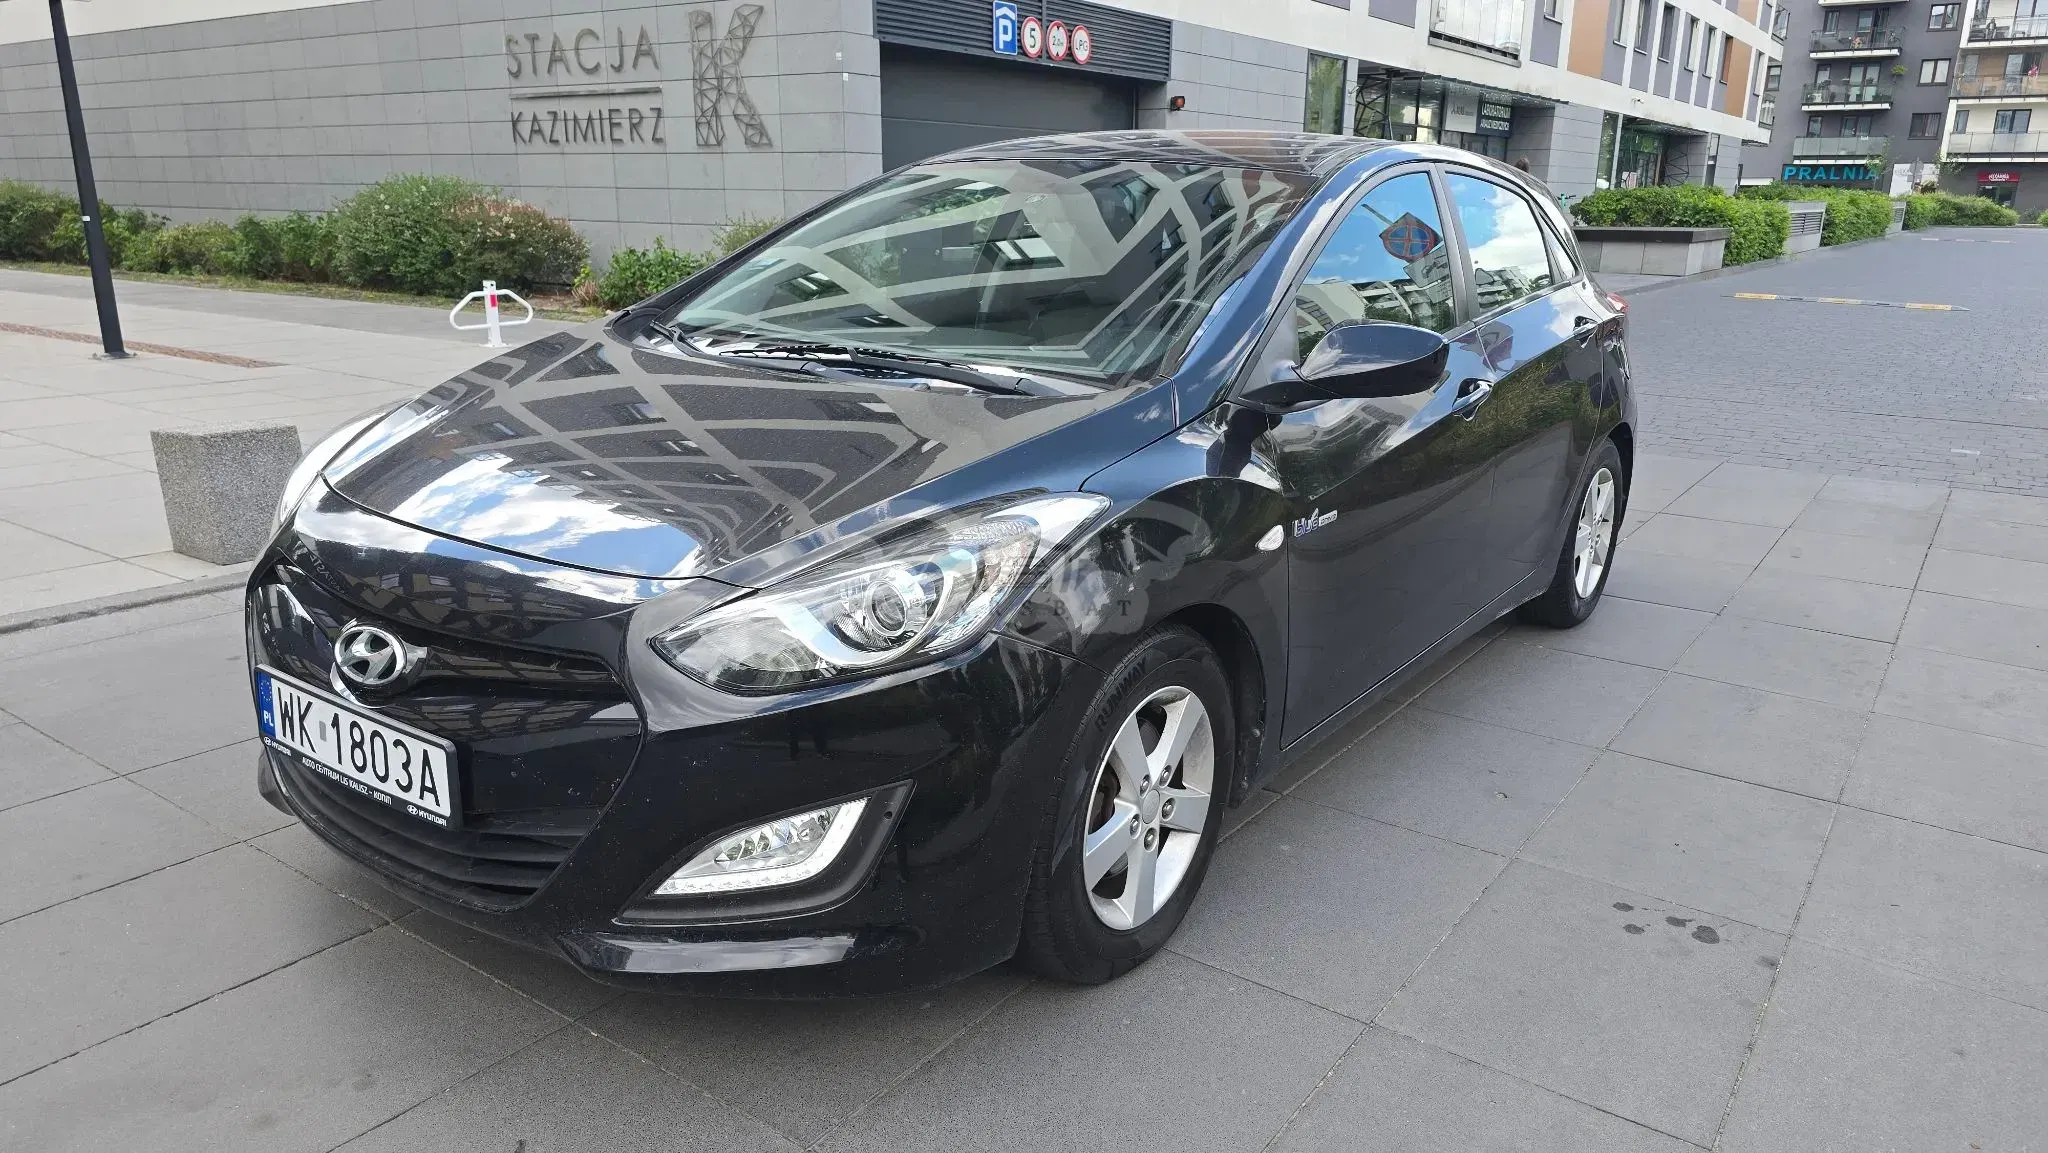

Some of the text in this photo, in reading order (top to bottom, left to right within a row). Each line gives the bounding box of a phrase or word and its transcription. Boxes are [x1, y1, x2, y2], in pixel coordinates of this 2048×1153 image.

[999, 18, 1012, 49] P
[1028, 27, 1037, 49] 5
[504, 24, 660, 79] STACJA
[509, 107, 666, 146] KAZIMIERZ
[1783, 166, 1879, 181] PRALNIA
[263, 709, 274, 727] PL
[278, 687, 441, 808] WK 1803A
[302, 757, 316, 770] AUTO
[349, 779, 369, 796] KALISZ
